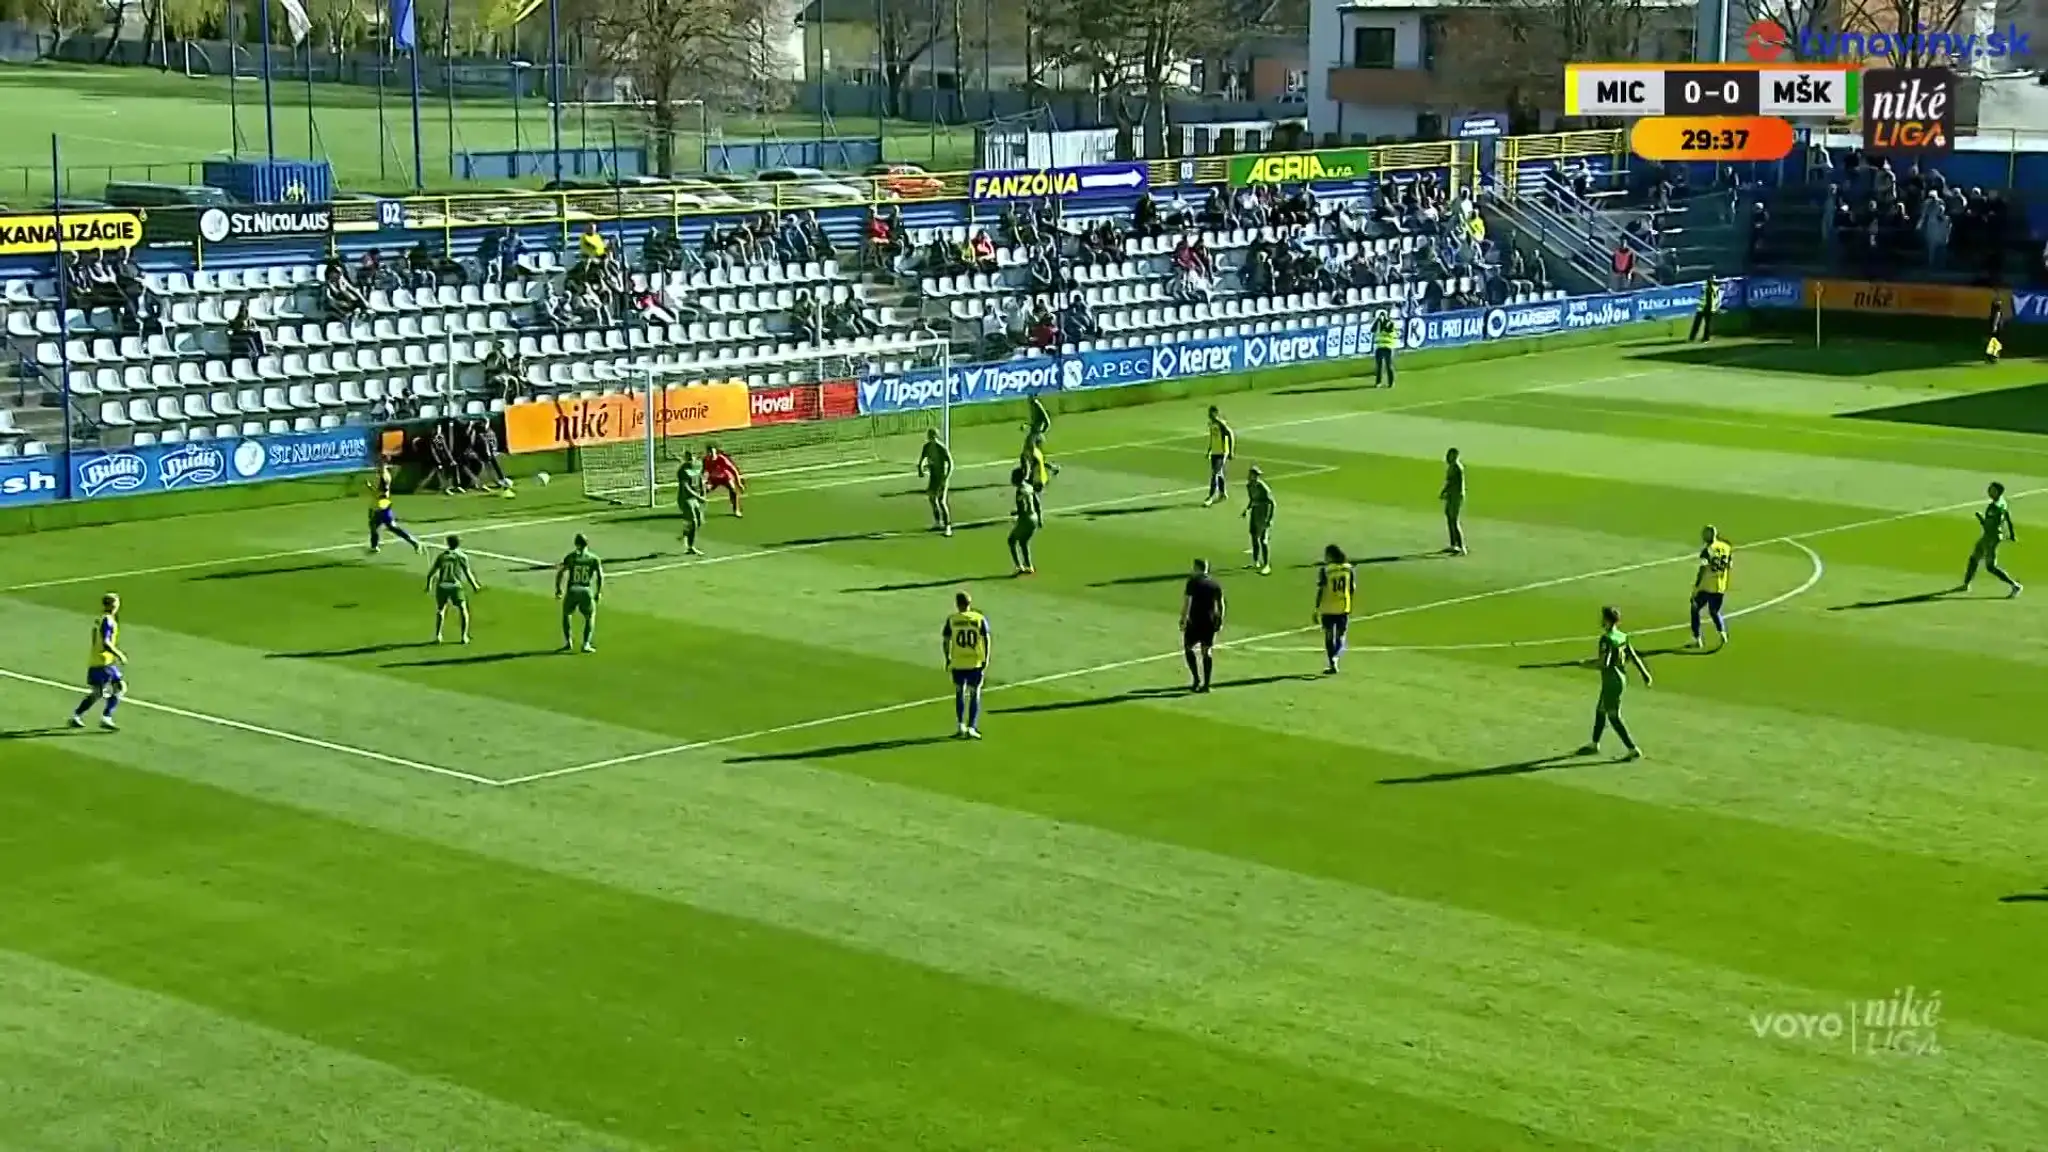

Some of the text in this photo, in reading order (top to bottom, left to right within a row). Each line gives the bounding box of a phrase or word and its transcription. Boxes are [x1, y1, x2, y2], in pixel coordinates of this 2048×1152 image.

[1246, 155, 1327, 183] AGRIA
[0, 219, 135, 246] KANALIZÁCIE
[983, 362, 1060, 396] Tipsport
[1085, 358, 1151, 380] APEC
[751, 388, 795, 414] Hoval
[554, 399, 609, 442] niké
[0, 470, 55, 494] sh
[956, 629, 978, 650] 40
